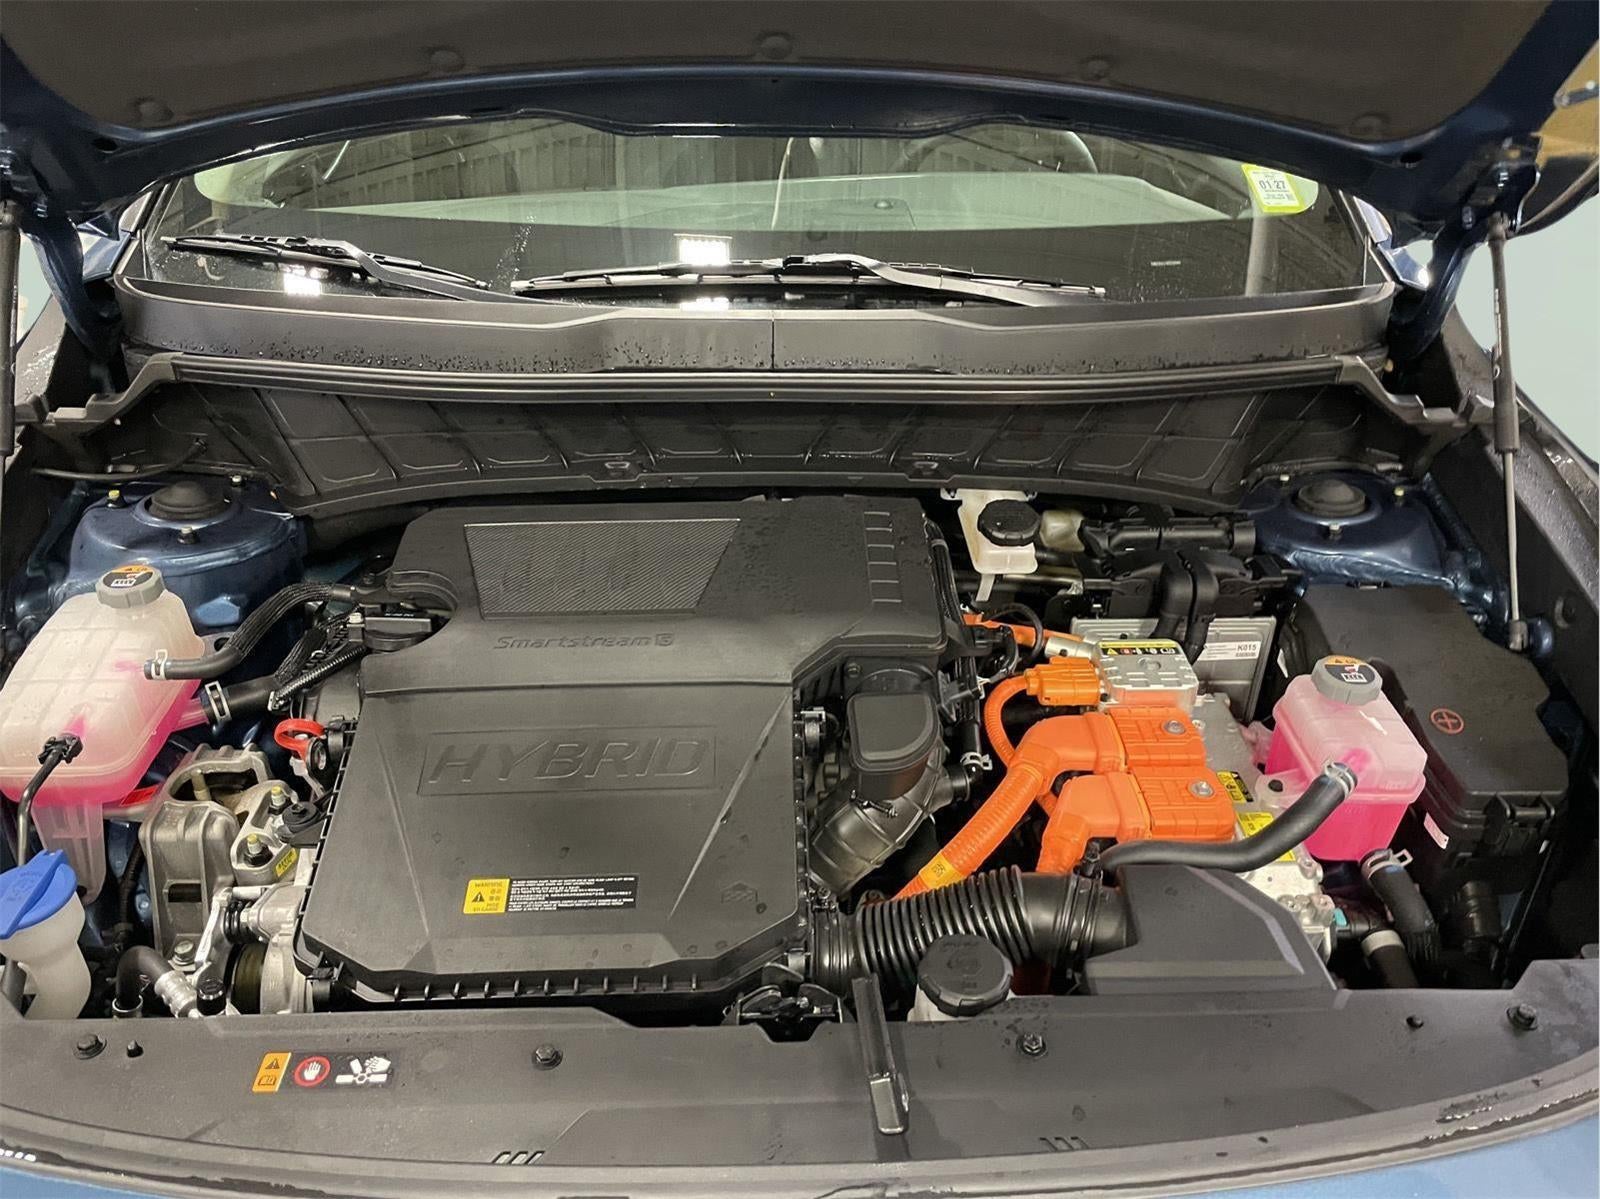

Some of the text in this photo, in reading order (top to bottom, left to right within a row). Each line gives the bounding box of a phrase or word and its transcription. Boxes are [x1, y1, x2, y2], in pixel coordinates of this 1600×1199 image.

[495, 636, 651, 649] Smartstream
[1237, 643, 1257, 651] K015
[428, 737, 706, 783] HYBRID
